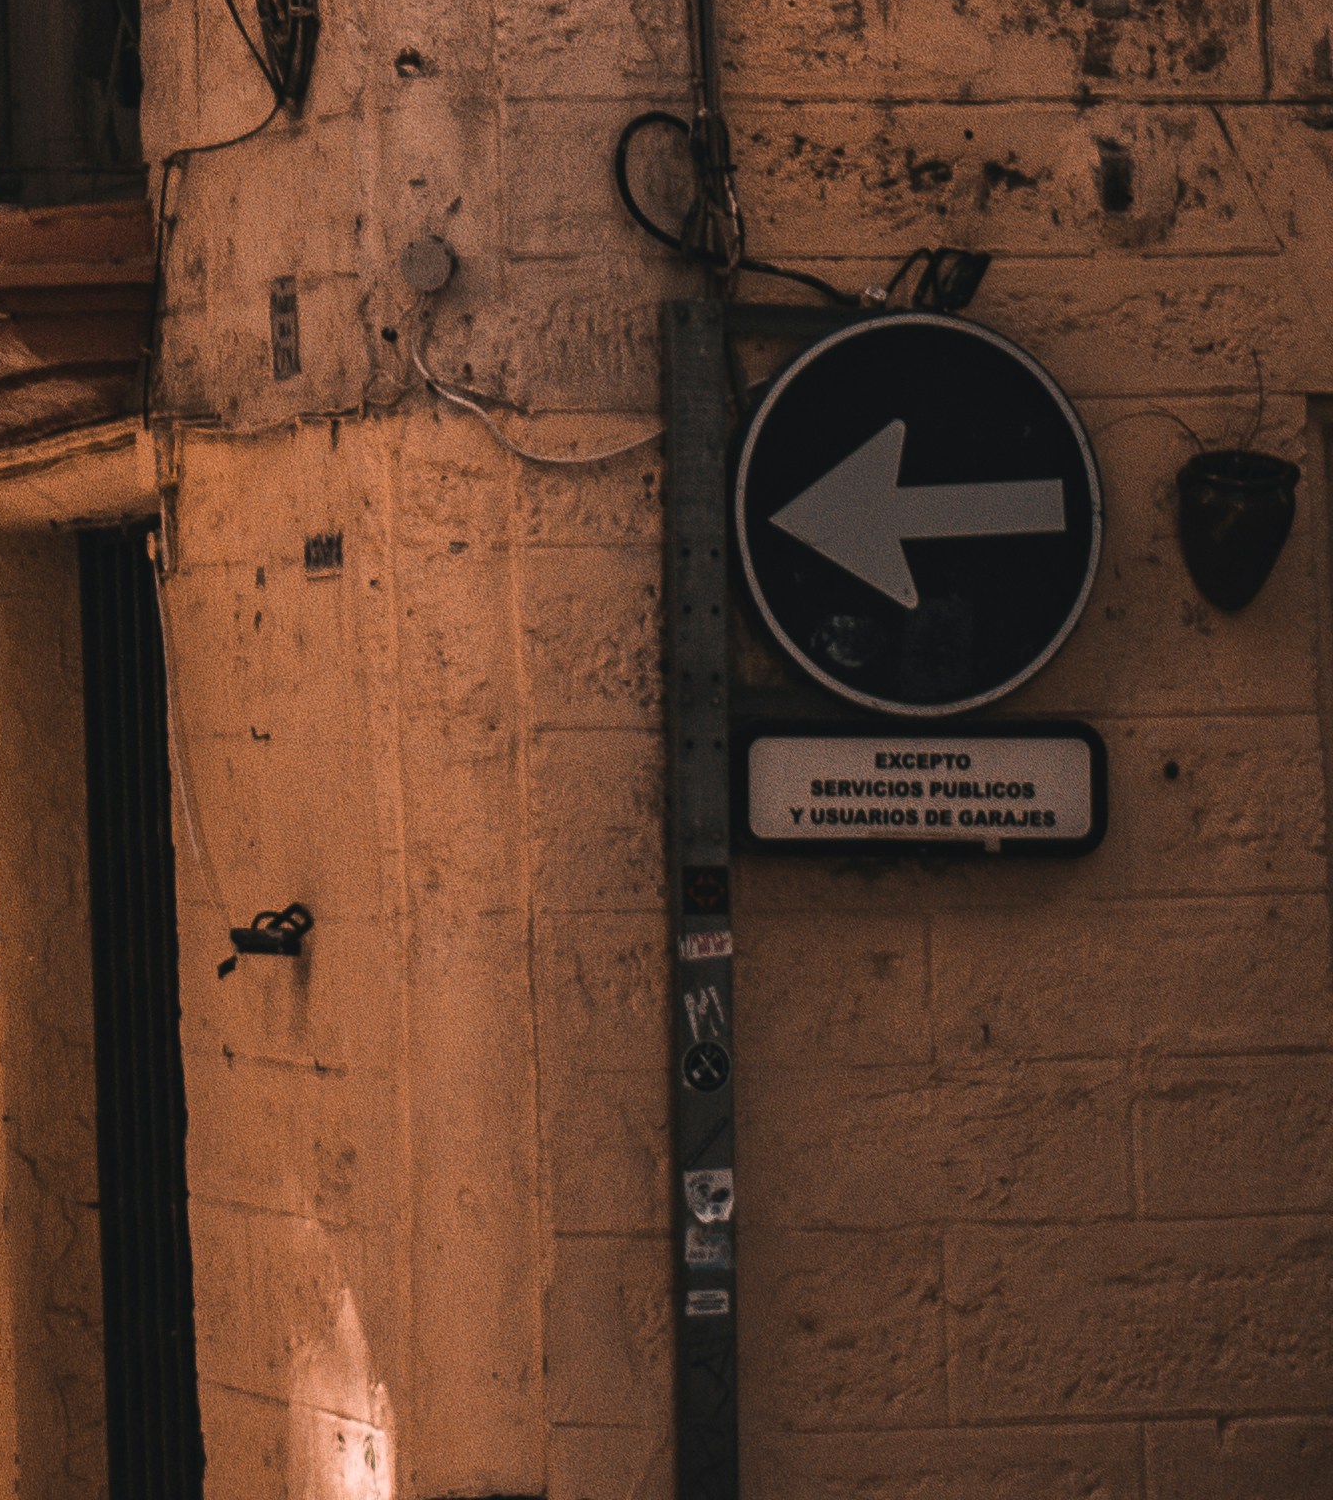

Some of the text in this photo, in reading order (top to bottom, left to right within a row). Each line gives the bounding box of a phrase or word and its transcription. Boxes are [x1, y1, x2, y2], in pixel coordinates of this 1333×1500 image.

[875, 752, 972, 770] EXCEPTO
[810, 780, 1036, 799] SERVICIOS PUBLICOS
[789, 808, 1056, 827] Y USUARIOS DE GARAJES
